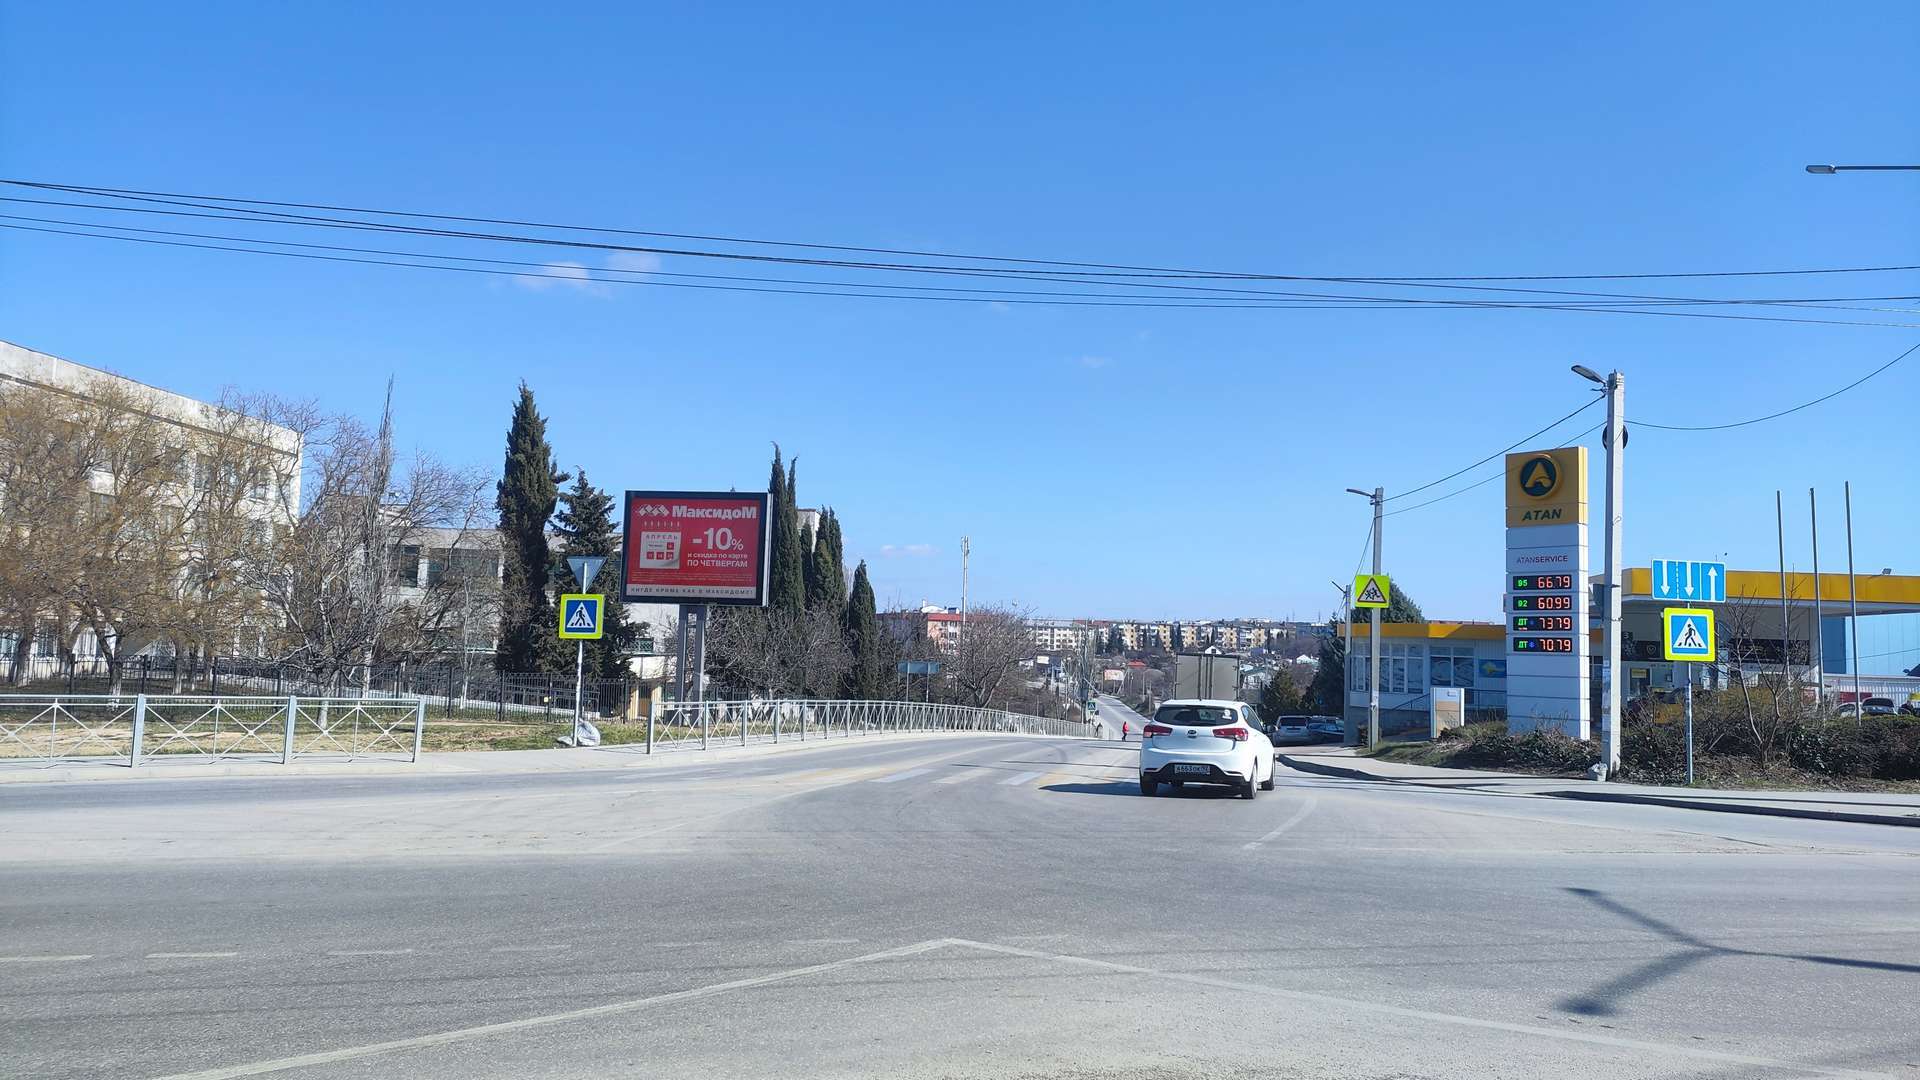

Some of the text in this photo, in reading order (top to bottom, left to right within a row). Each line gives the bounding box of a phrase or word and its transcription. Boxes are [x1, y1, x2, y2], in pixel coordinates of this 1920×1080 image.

[1522, 508, 1562, 521] ATAN
[692, 527, 744, 551] -10%
[687, 559, 748, 567] ПО ЧЕТВЕРГАМ
[1516, 555, 1568, 564] ATANSERVICE
[1517, 579, 1528, 587] 95
[1517, 600, 1528, 608] 92
[1517, 618, 1528, 626] ДТ
[1517, 640, 1528, 649] ДТ
